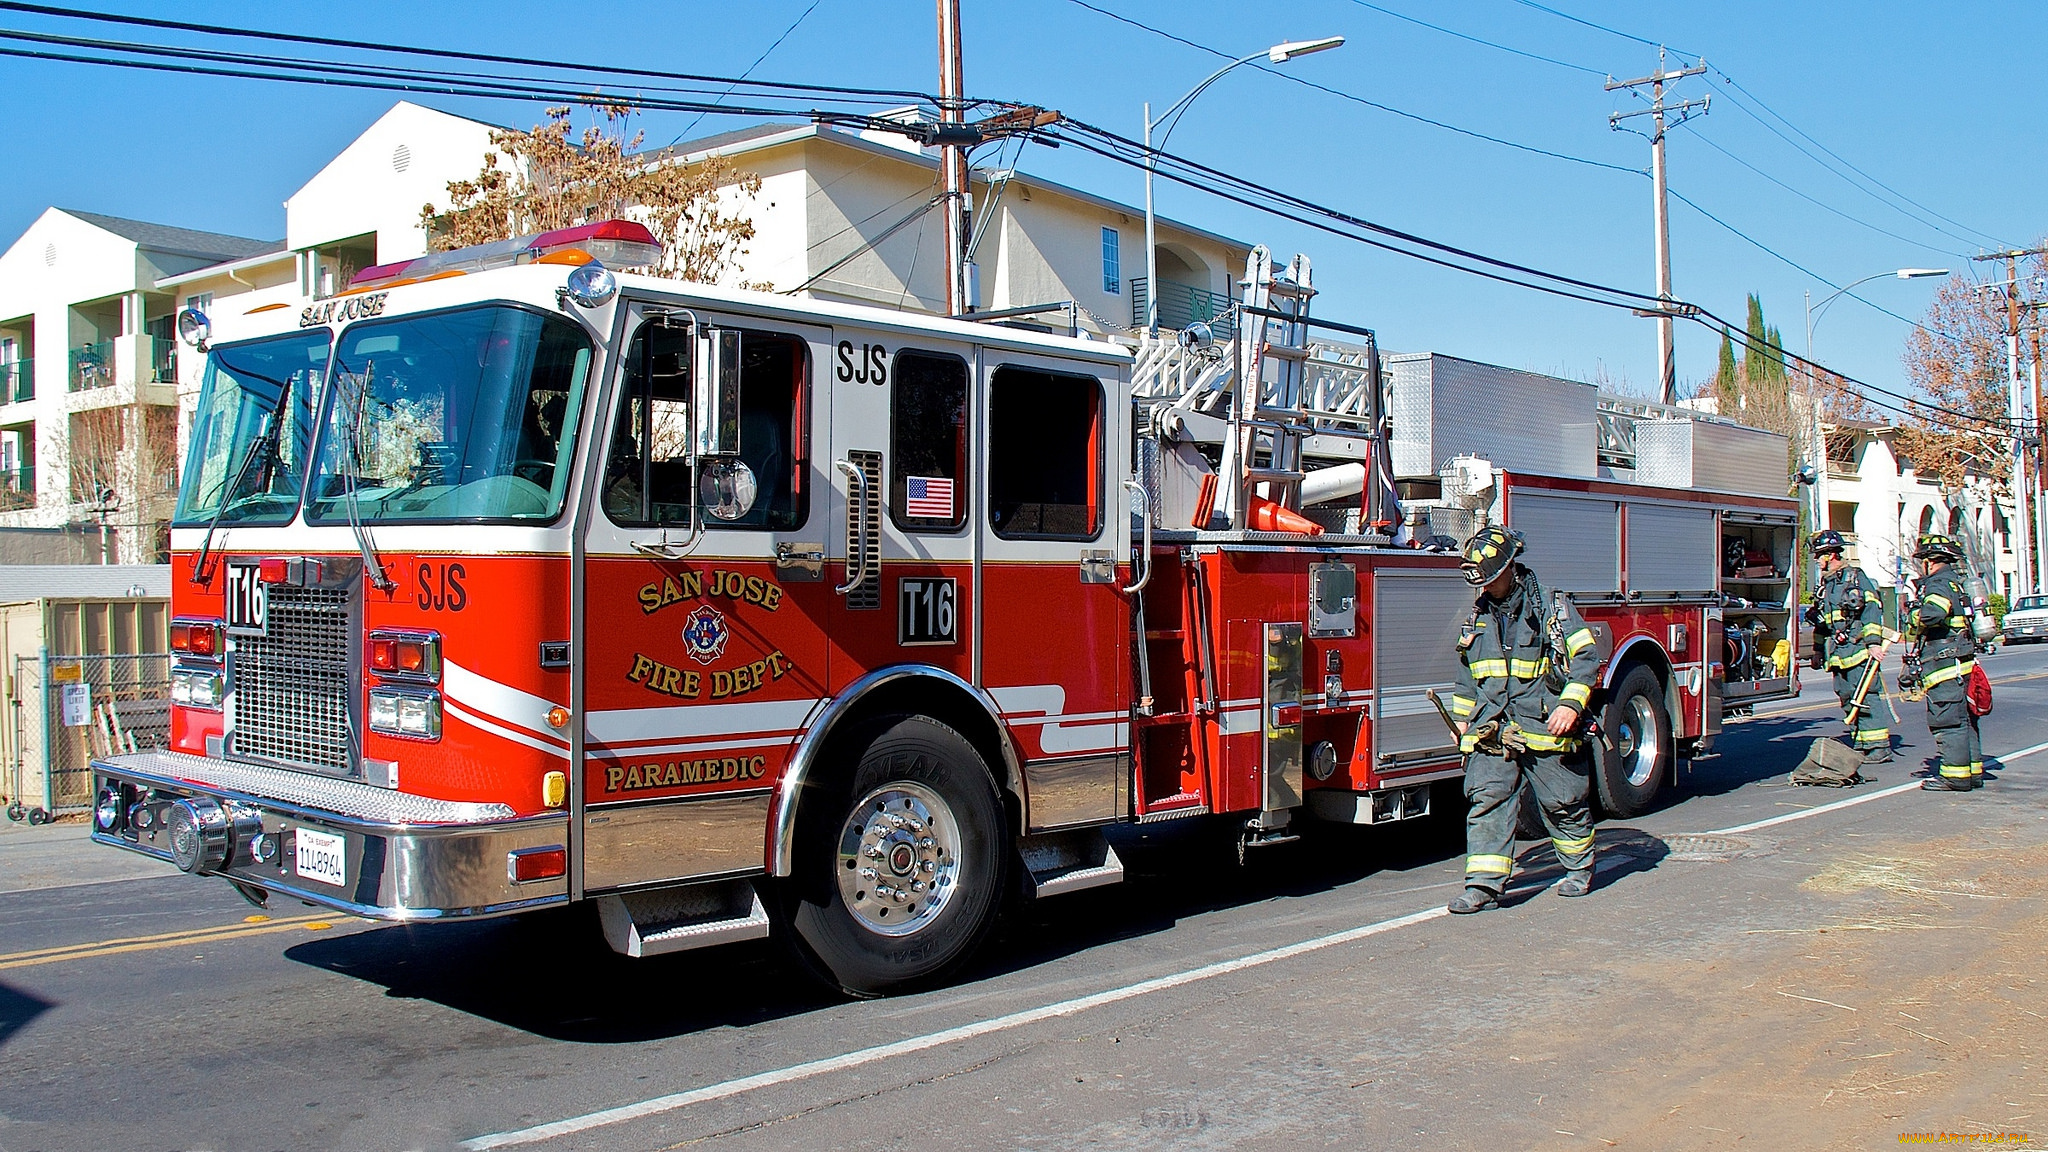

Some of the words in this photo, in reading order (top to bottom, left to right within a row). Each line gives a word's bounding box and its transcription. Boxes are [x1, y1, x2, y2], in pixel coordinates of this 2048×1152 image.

[300, 300, 341, 328] SAN
[338, 292, 389, 323] JOSE
[837, 340, 887, 386] SJS
[228, 567, 265, 625] T16
[418, 563, 466, 611] SJS
[638, 570, 704, 615] SAN
[708, 570, 783, 612] JOSE
[904, 582, 952, 635] T16
[628, 653, 701, 698] FIRE
[711, 650, 793, 698] DEPT.
[605, 755, 766, 793] PARAMEDIC
[300, 846, 341, 877] 1148964
